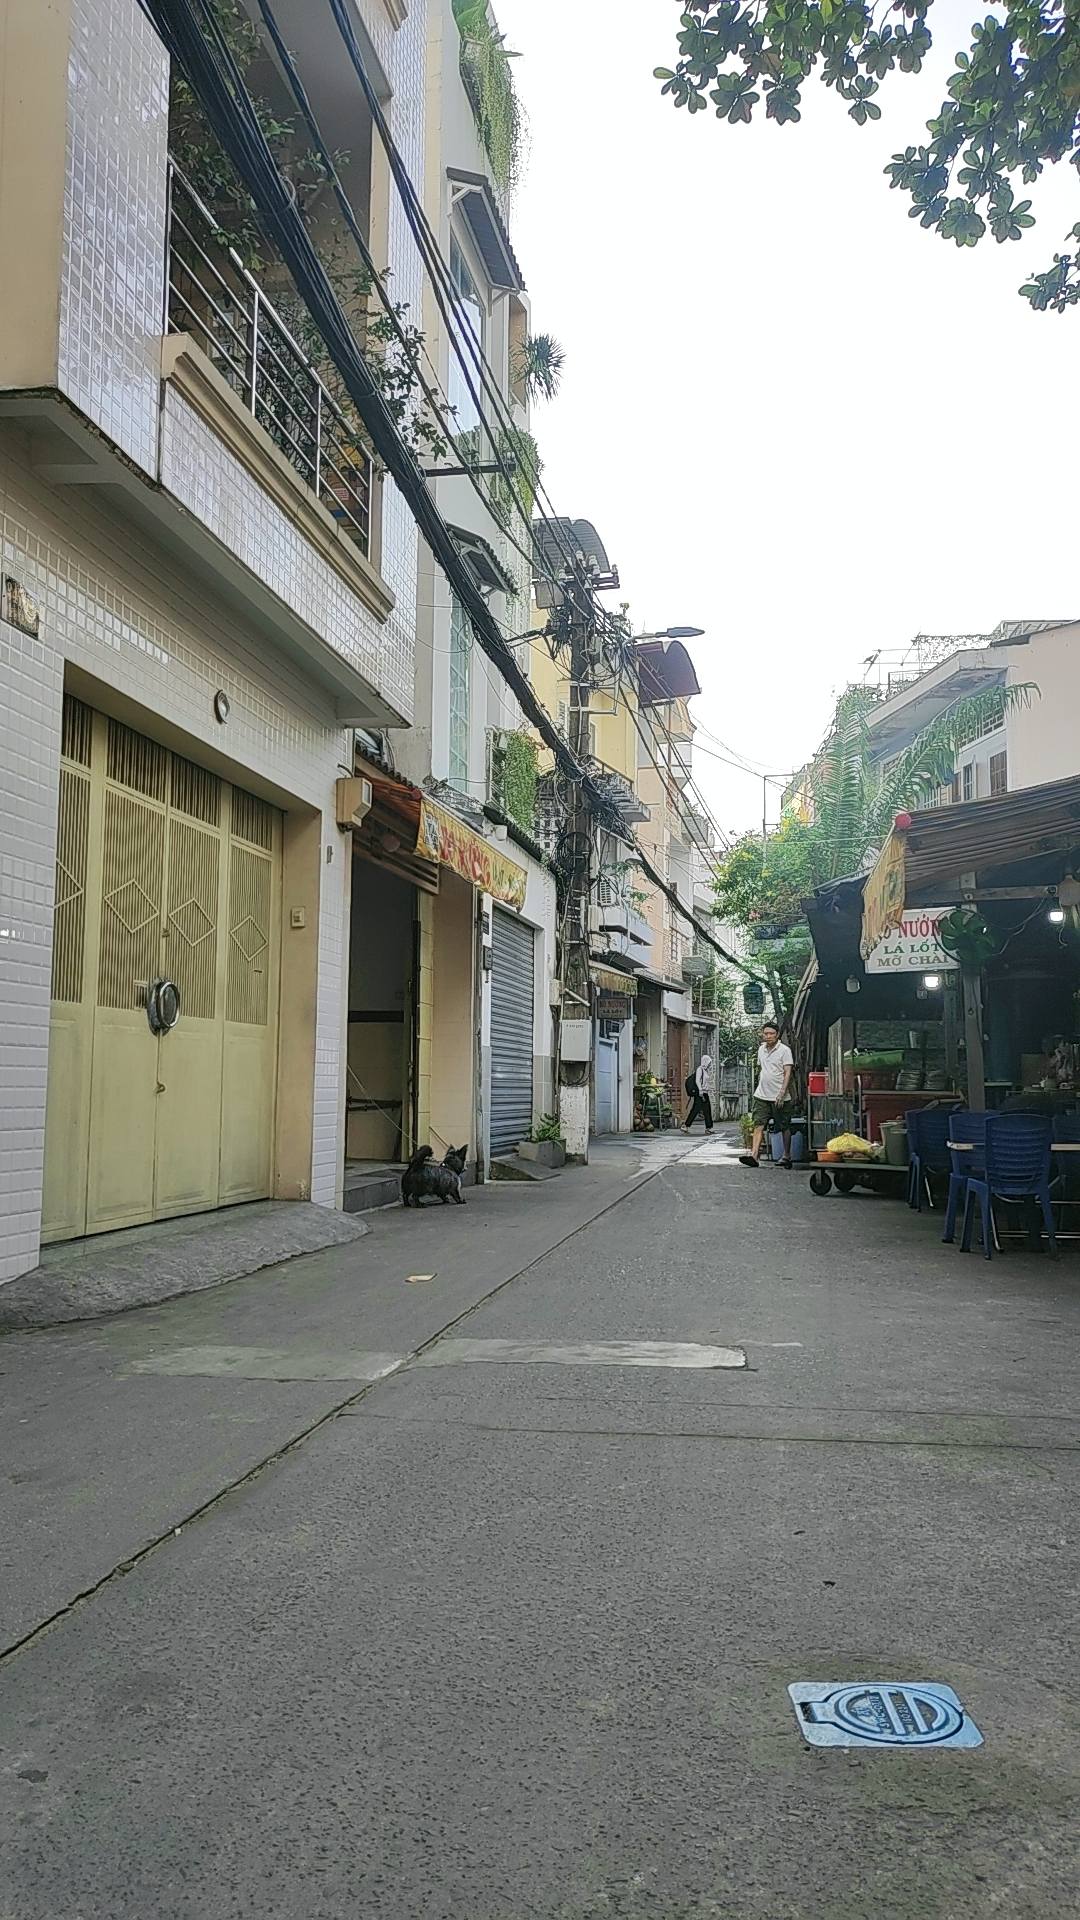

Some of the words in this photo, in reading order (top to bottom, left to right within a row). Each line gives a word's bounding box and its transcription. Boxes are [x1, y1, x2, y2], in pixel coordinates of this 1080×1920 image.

[898, 914, 942, 938] NƯỚN
[884, 941, 905, 954] LÁ
[877, 954, 902, 967] MỠ
